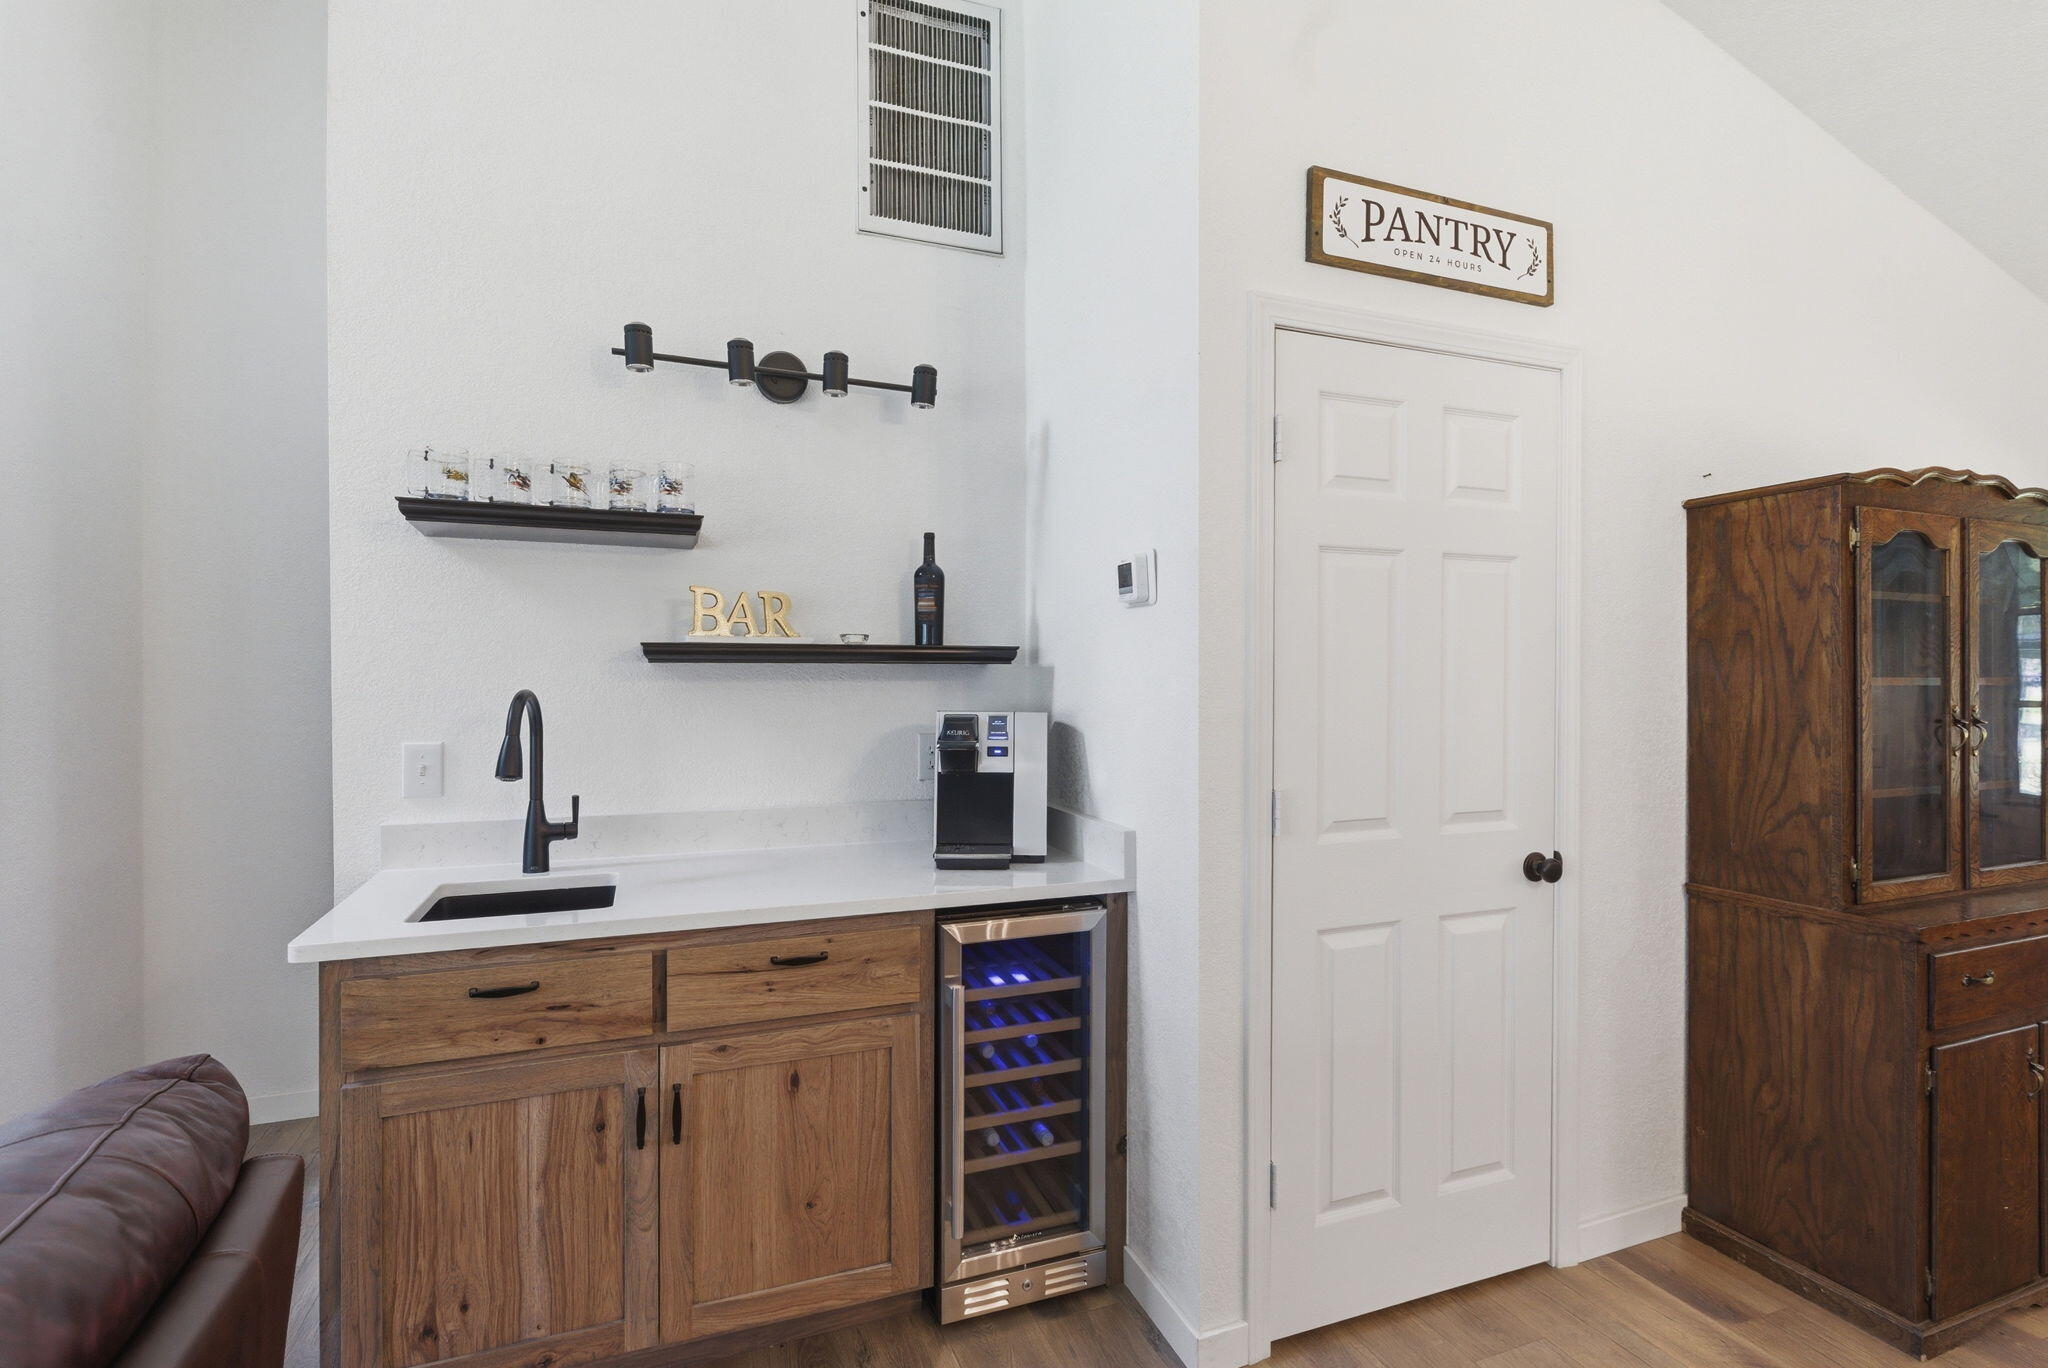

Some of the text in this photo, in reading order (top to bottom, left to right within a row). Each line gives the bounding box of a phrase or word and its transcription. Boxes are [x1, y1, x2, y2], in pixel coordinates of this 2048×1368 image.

[1361, 199, 1517, 271] PANTRY
[1393, 247, 1483, 272] OPEN 24 HOURS
[688, 585, 800, 638] BAR
